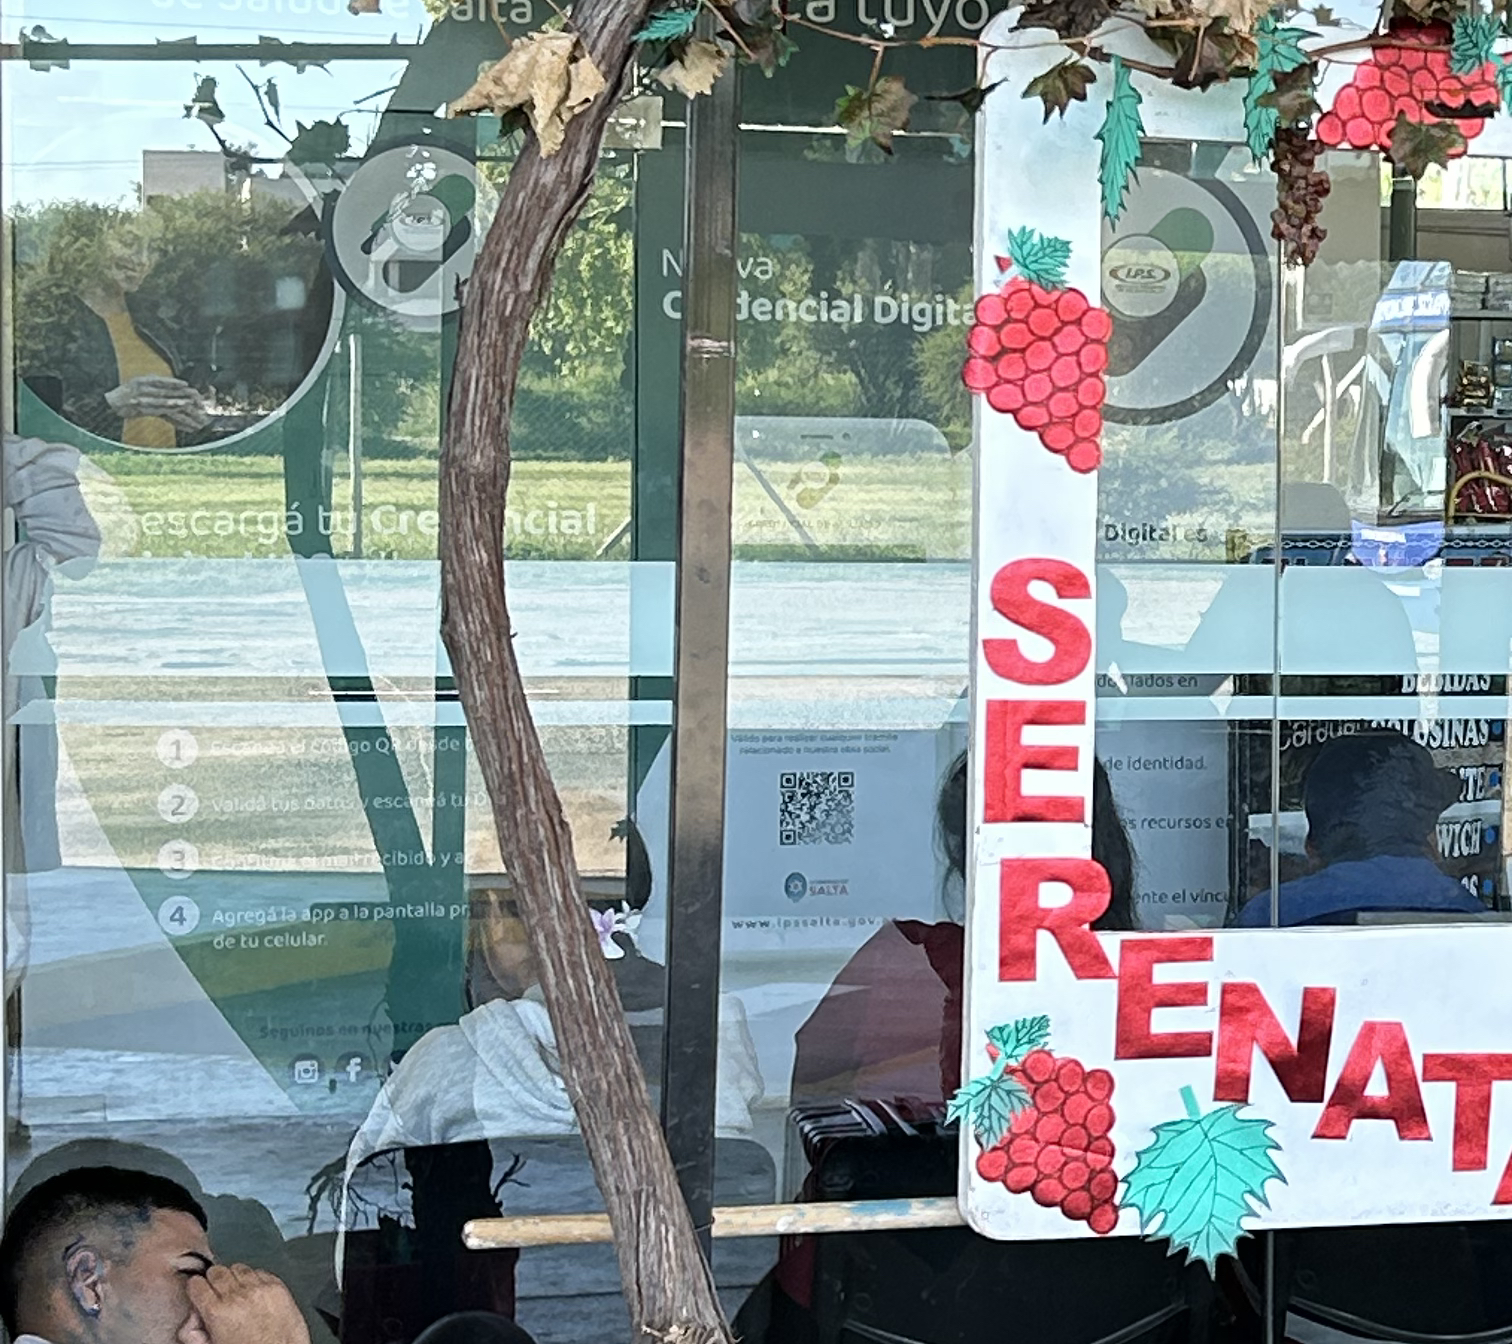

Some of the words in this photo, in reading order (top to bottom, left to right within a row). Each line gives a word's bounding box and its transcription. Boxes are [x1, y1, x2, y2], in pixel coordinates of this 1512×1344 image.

[662, 248, 773, 280] Nva
[662, 291, 864, 324] Cdencial
[873, 293, 978, 332] Digita
[140, 503, 304, 543] escargá
[171, 794, 186, 816] 2
[1140, 817, 1212, 831] recursos
[168, 905, 187, 926] 4
[301, 907, 335, 925] app
[373, 902, 446, 923] pantalla
[212, 933, 236, 950] de
[240, 933, 259, 949] tu
